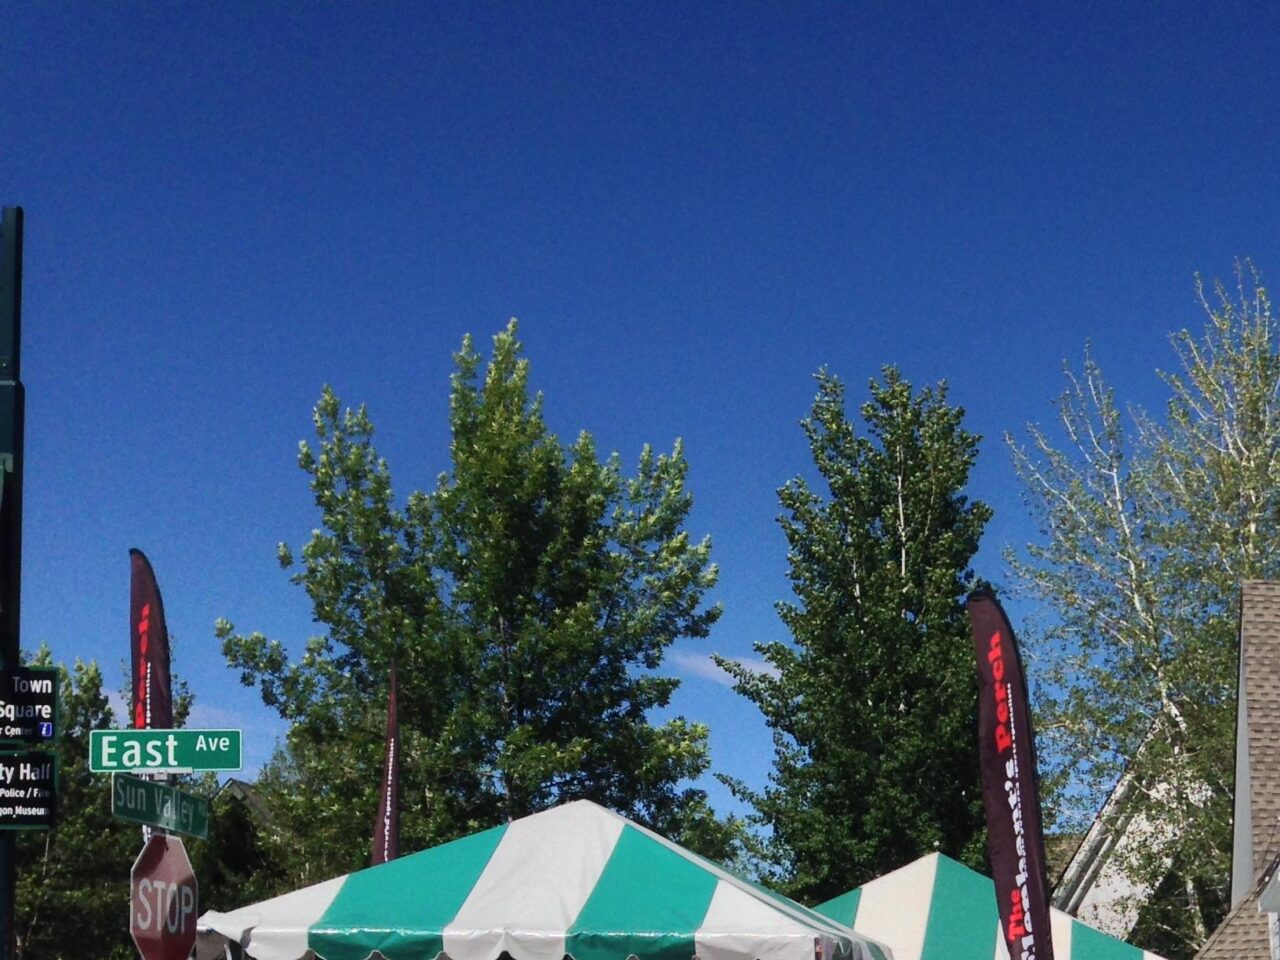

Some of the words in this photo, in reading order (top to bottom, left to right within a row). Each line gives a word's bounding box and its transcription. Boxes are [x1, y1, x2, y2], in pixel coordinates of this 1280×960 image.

[13, 676, 52, 693] Town
[988, 632, 1012, 753] Perch
[101, 735, 178, 767] East
[195, 735, 230, 751] Ave
[0, 763, 15, 784] ty
[20, 763, 50, 780] Hall
[15, 806, 49, 816] Museum
[117, 778, 146, 812] Sun
[154, 786, 194, 831] Valley
[137, 878, 193, 934] STOP
[1008, 889, 1024, 942] The
